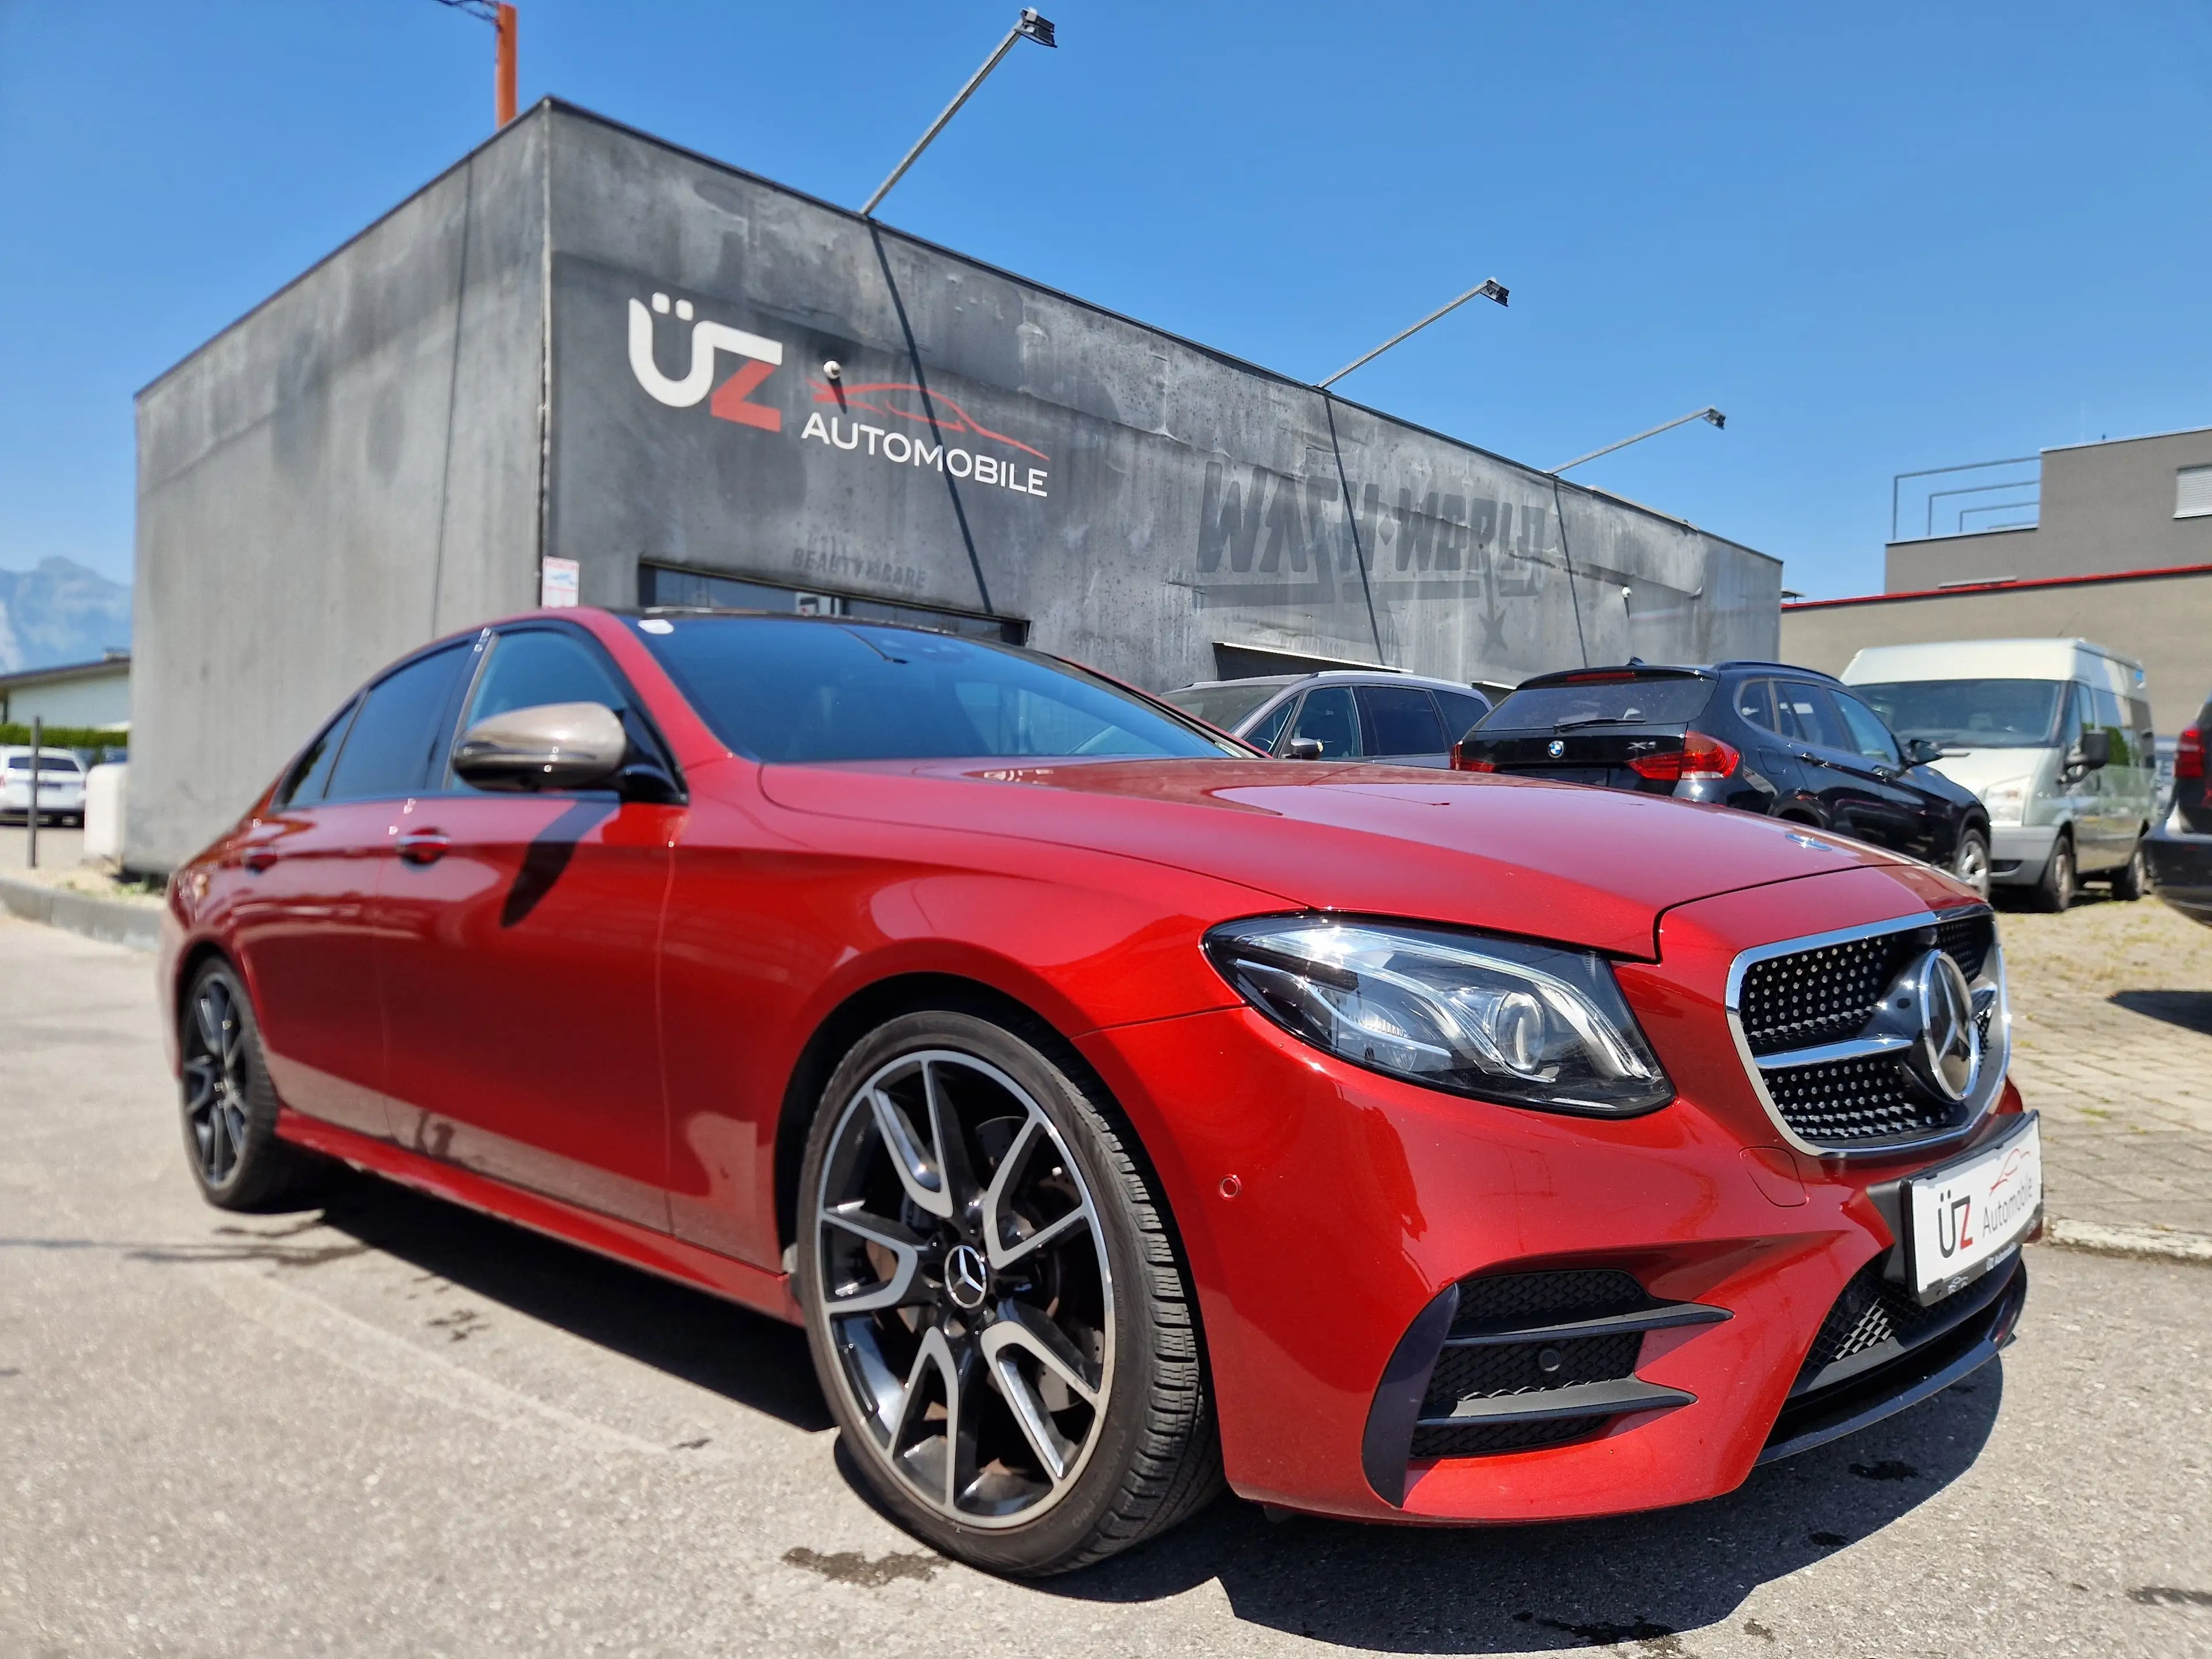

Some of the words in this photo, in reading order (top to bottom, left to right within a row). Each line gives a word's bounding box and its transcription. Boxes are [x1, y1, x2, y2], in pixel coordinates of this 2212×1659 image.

[628, 291, 783, 432] ÜZ
[800, 411, 1048, 498] AUTOMOBILE
[1938, 1189, 1974, 1258] ÜZ
[1982, 1172, 2033, 1238] Automobile
